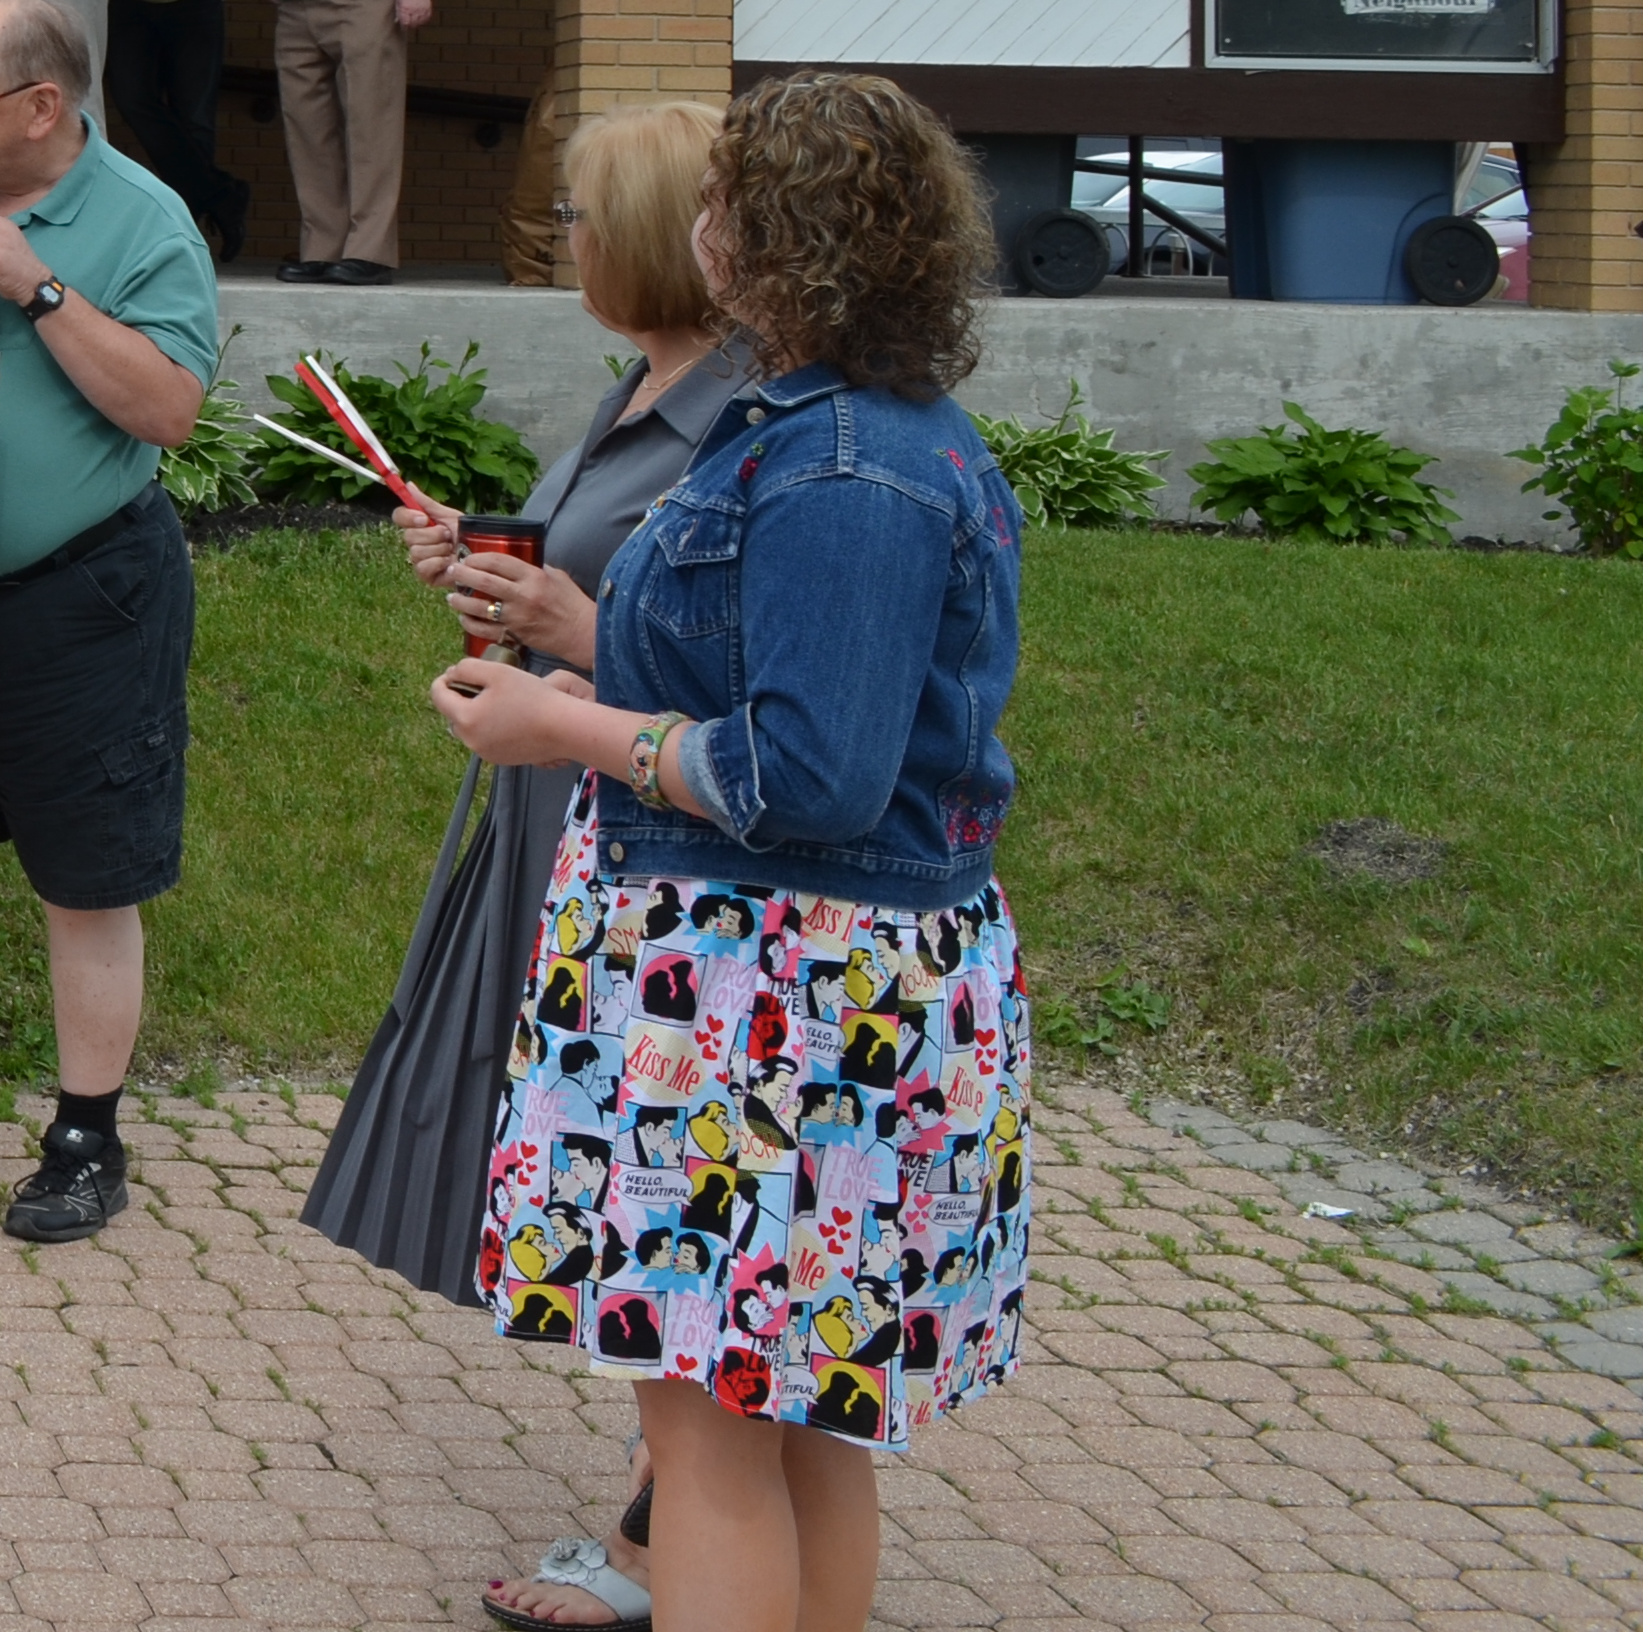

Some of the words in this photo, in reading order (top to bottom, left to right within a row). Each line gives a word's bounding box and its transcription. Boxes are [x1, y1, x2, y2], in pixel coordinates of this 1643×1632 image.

[628, 1034, 672, 1081] Kiss
[667, 1055, 700, 1095] Me
[832, 1146, 883, 1183] TRUE
[625, 1185, 688, 1198] BEAUTIFUL
